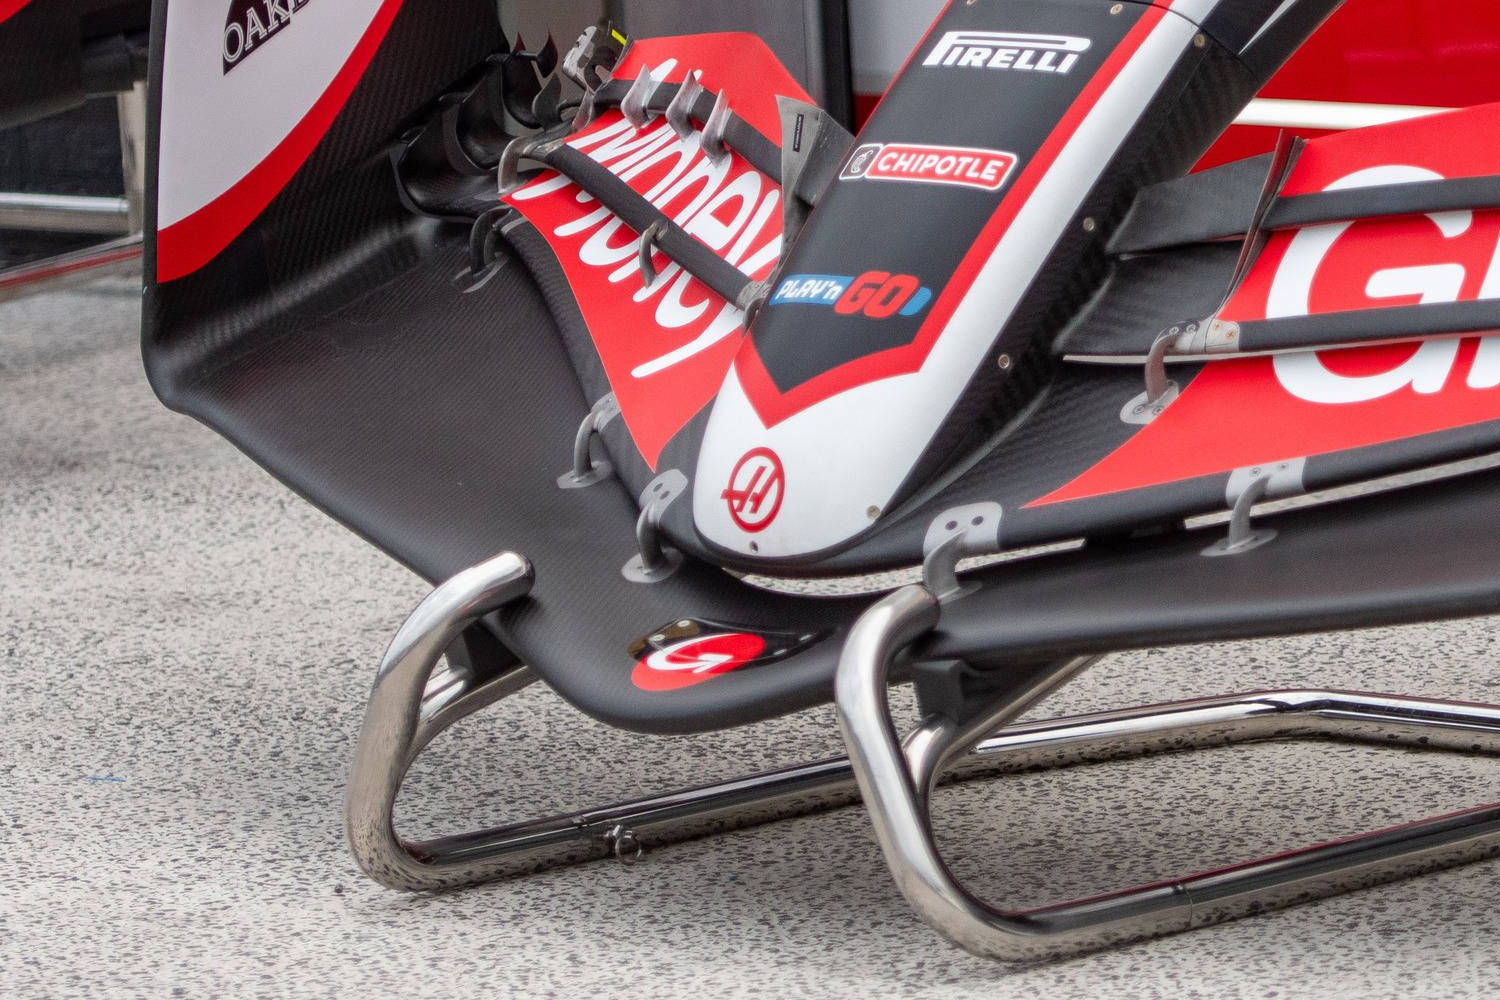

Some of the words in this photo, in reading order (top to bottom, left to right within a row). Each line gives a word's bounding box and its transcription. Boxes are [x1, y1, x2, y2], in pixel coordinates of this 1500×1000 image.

[922, 31, 1091, 74] PIRELLI
[877, 152, 1004, 180] CHIPOTLE
[834, 270, 920, 318] GO
